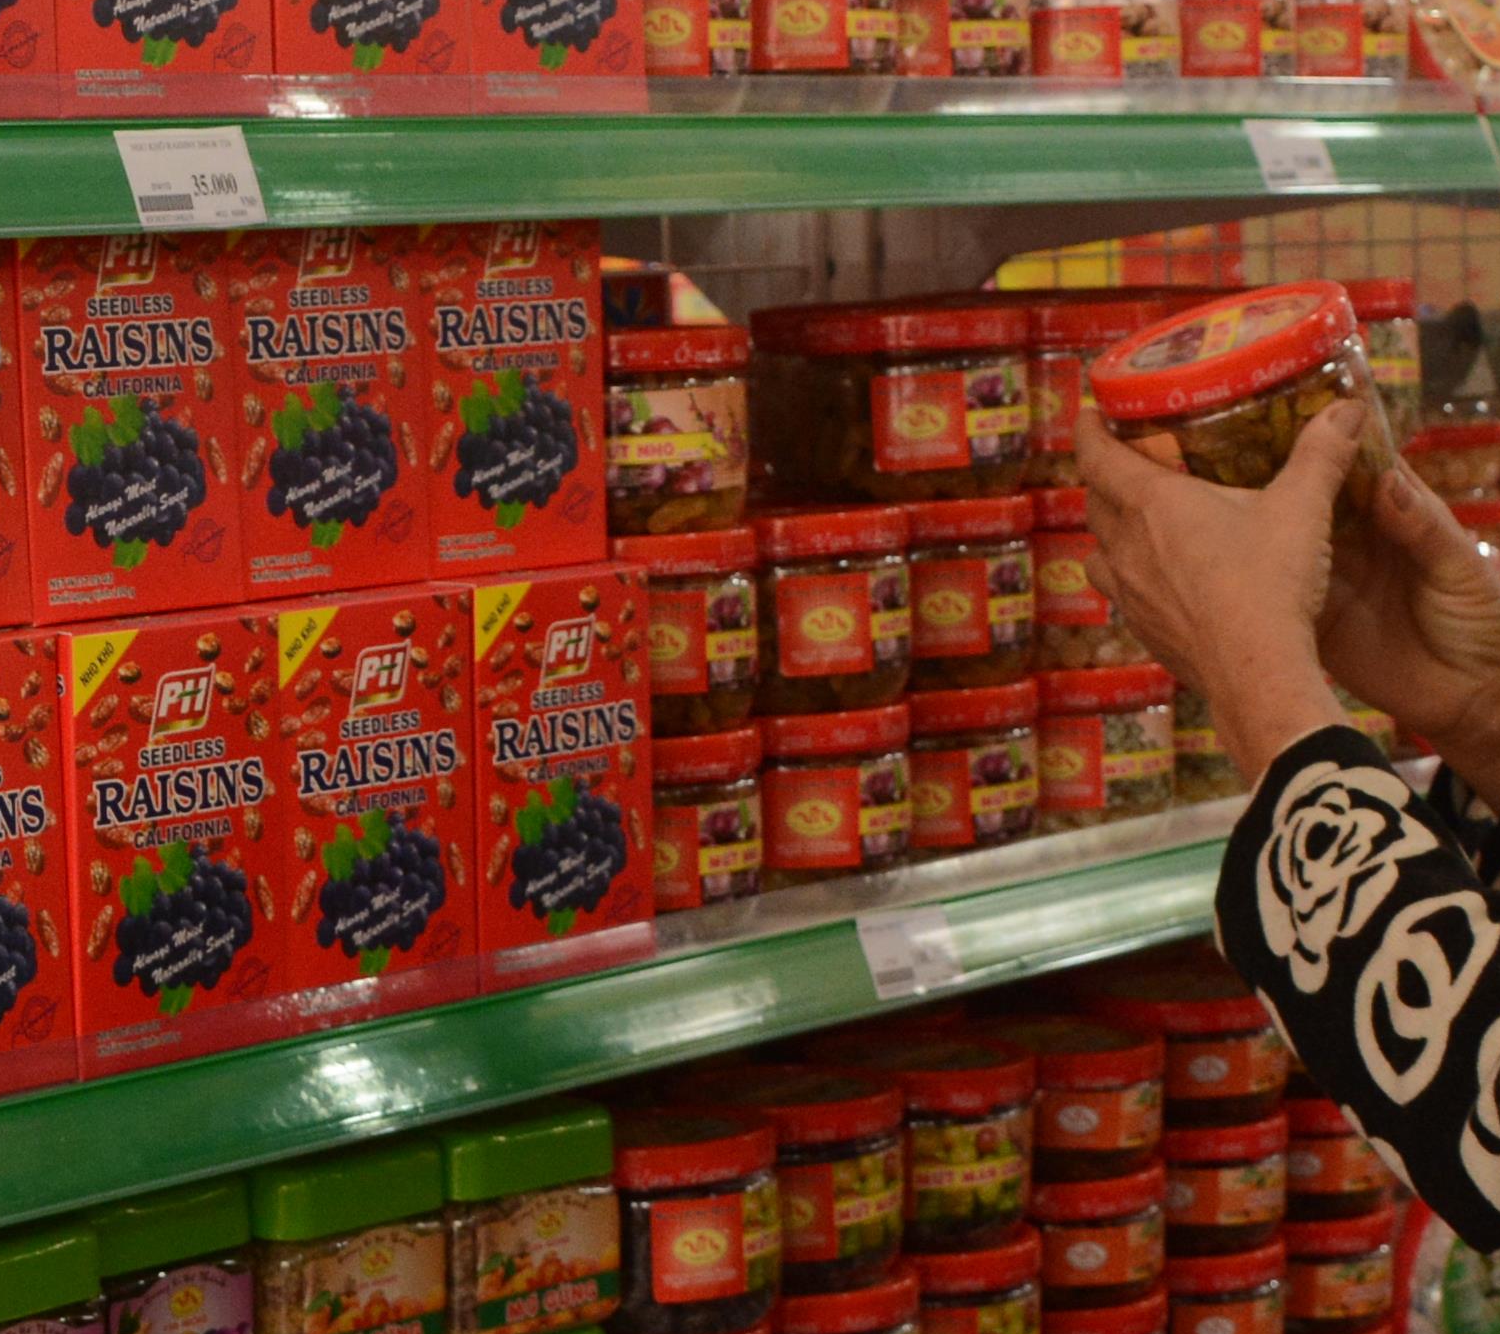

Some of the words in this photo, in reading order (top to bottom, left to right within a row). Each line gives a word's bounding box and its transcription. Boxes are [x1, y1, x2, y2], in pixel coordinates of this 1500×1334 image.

[192, 173, 238, 197] 35.000
[436, 299, 587, 352] RAISINS
[492, 700, 636, 764] RAISINS
[95, 758, 265, 829] RAISINS
